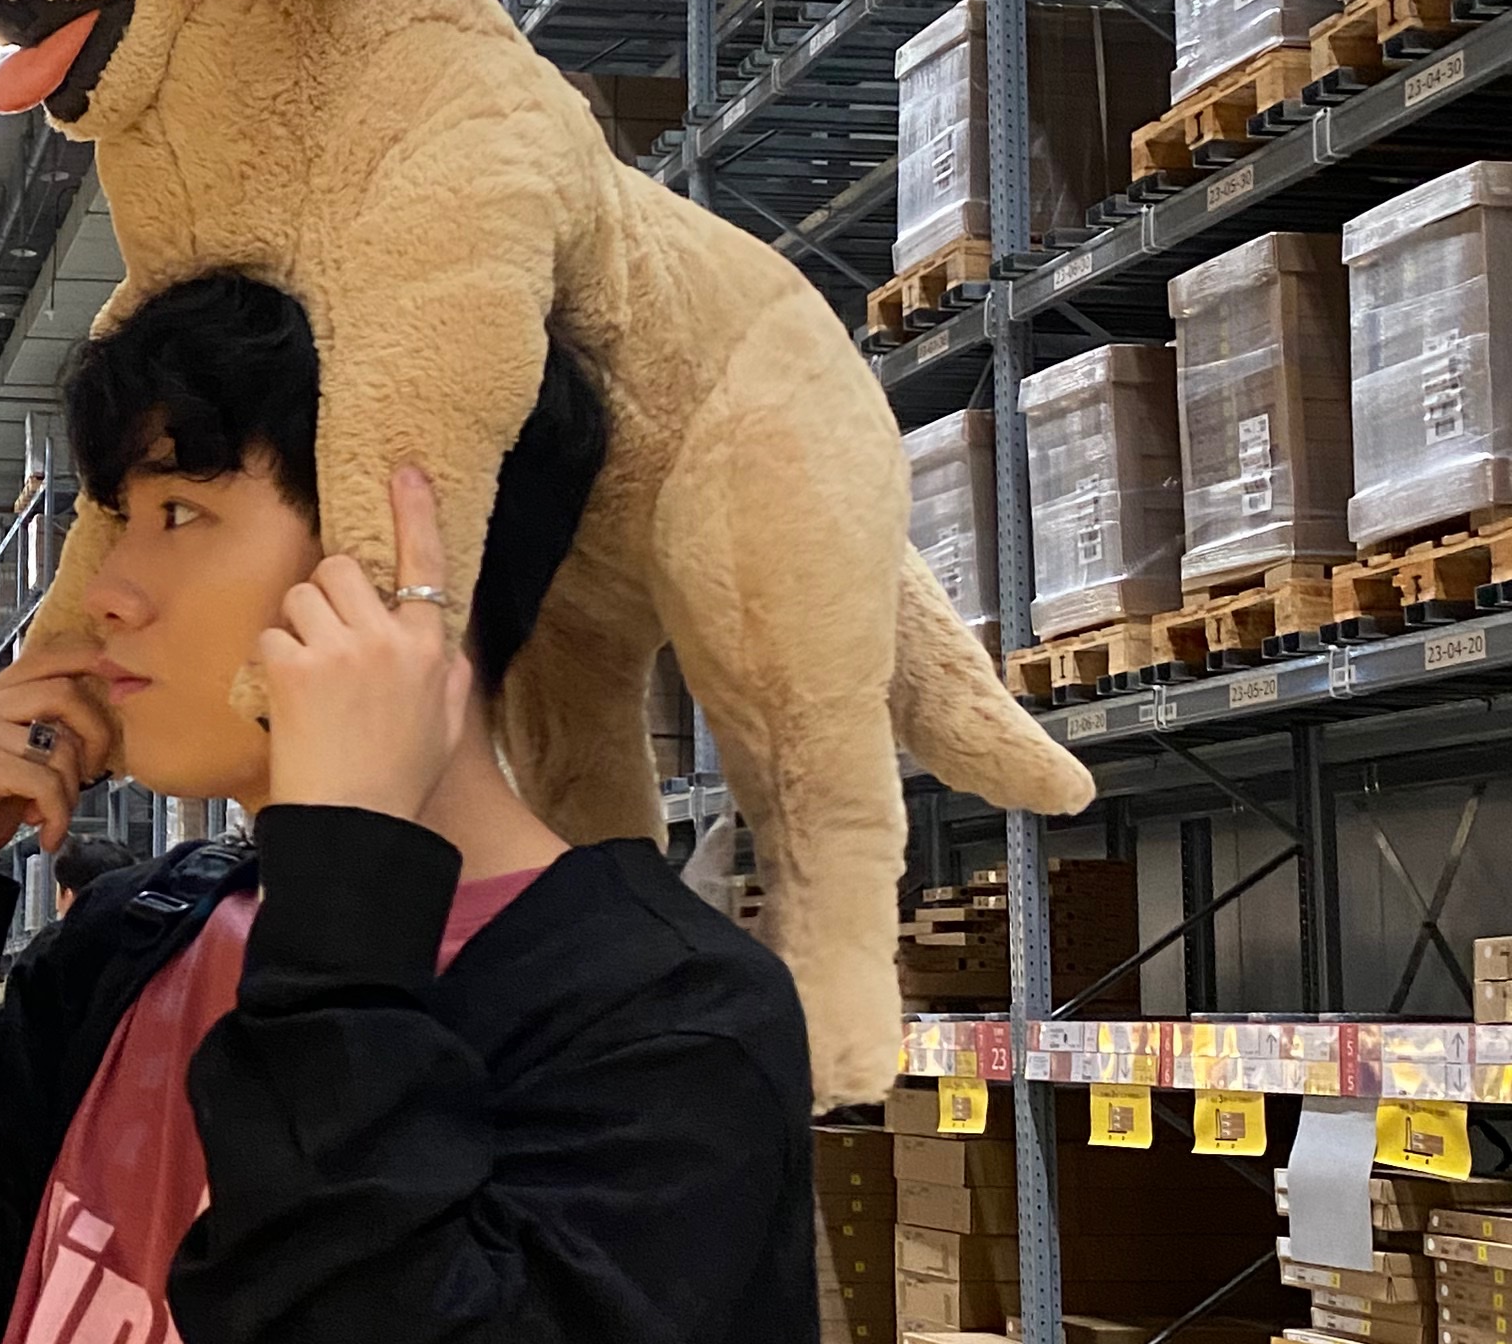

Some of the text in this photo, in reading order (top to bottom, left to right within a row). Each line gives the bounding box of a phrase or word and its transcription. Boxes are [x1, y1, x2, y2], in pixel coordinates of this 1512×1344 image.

[1406, 56, 1462, 100] 23-04-30
[1427, 637, 1484, 664] 23-04-20
[1231, 679, 1276, 703] 23-05-20
[991, 1047, 1007, 1071] 23
